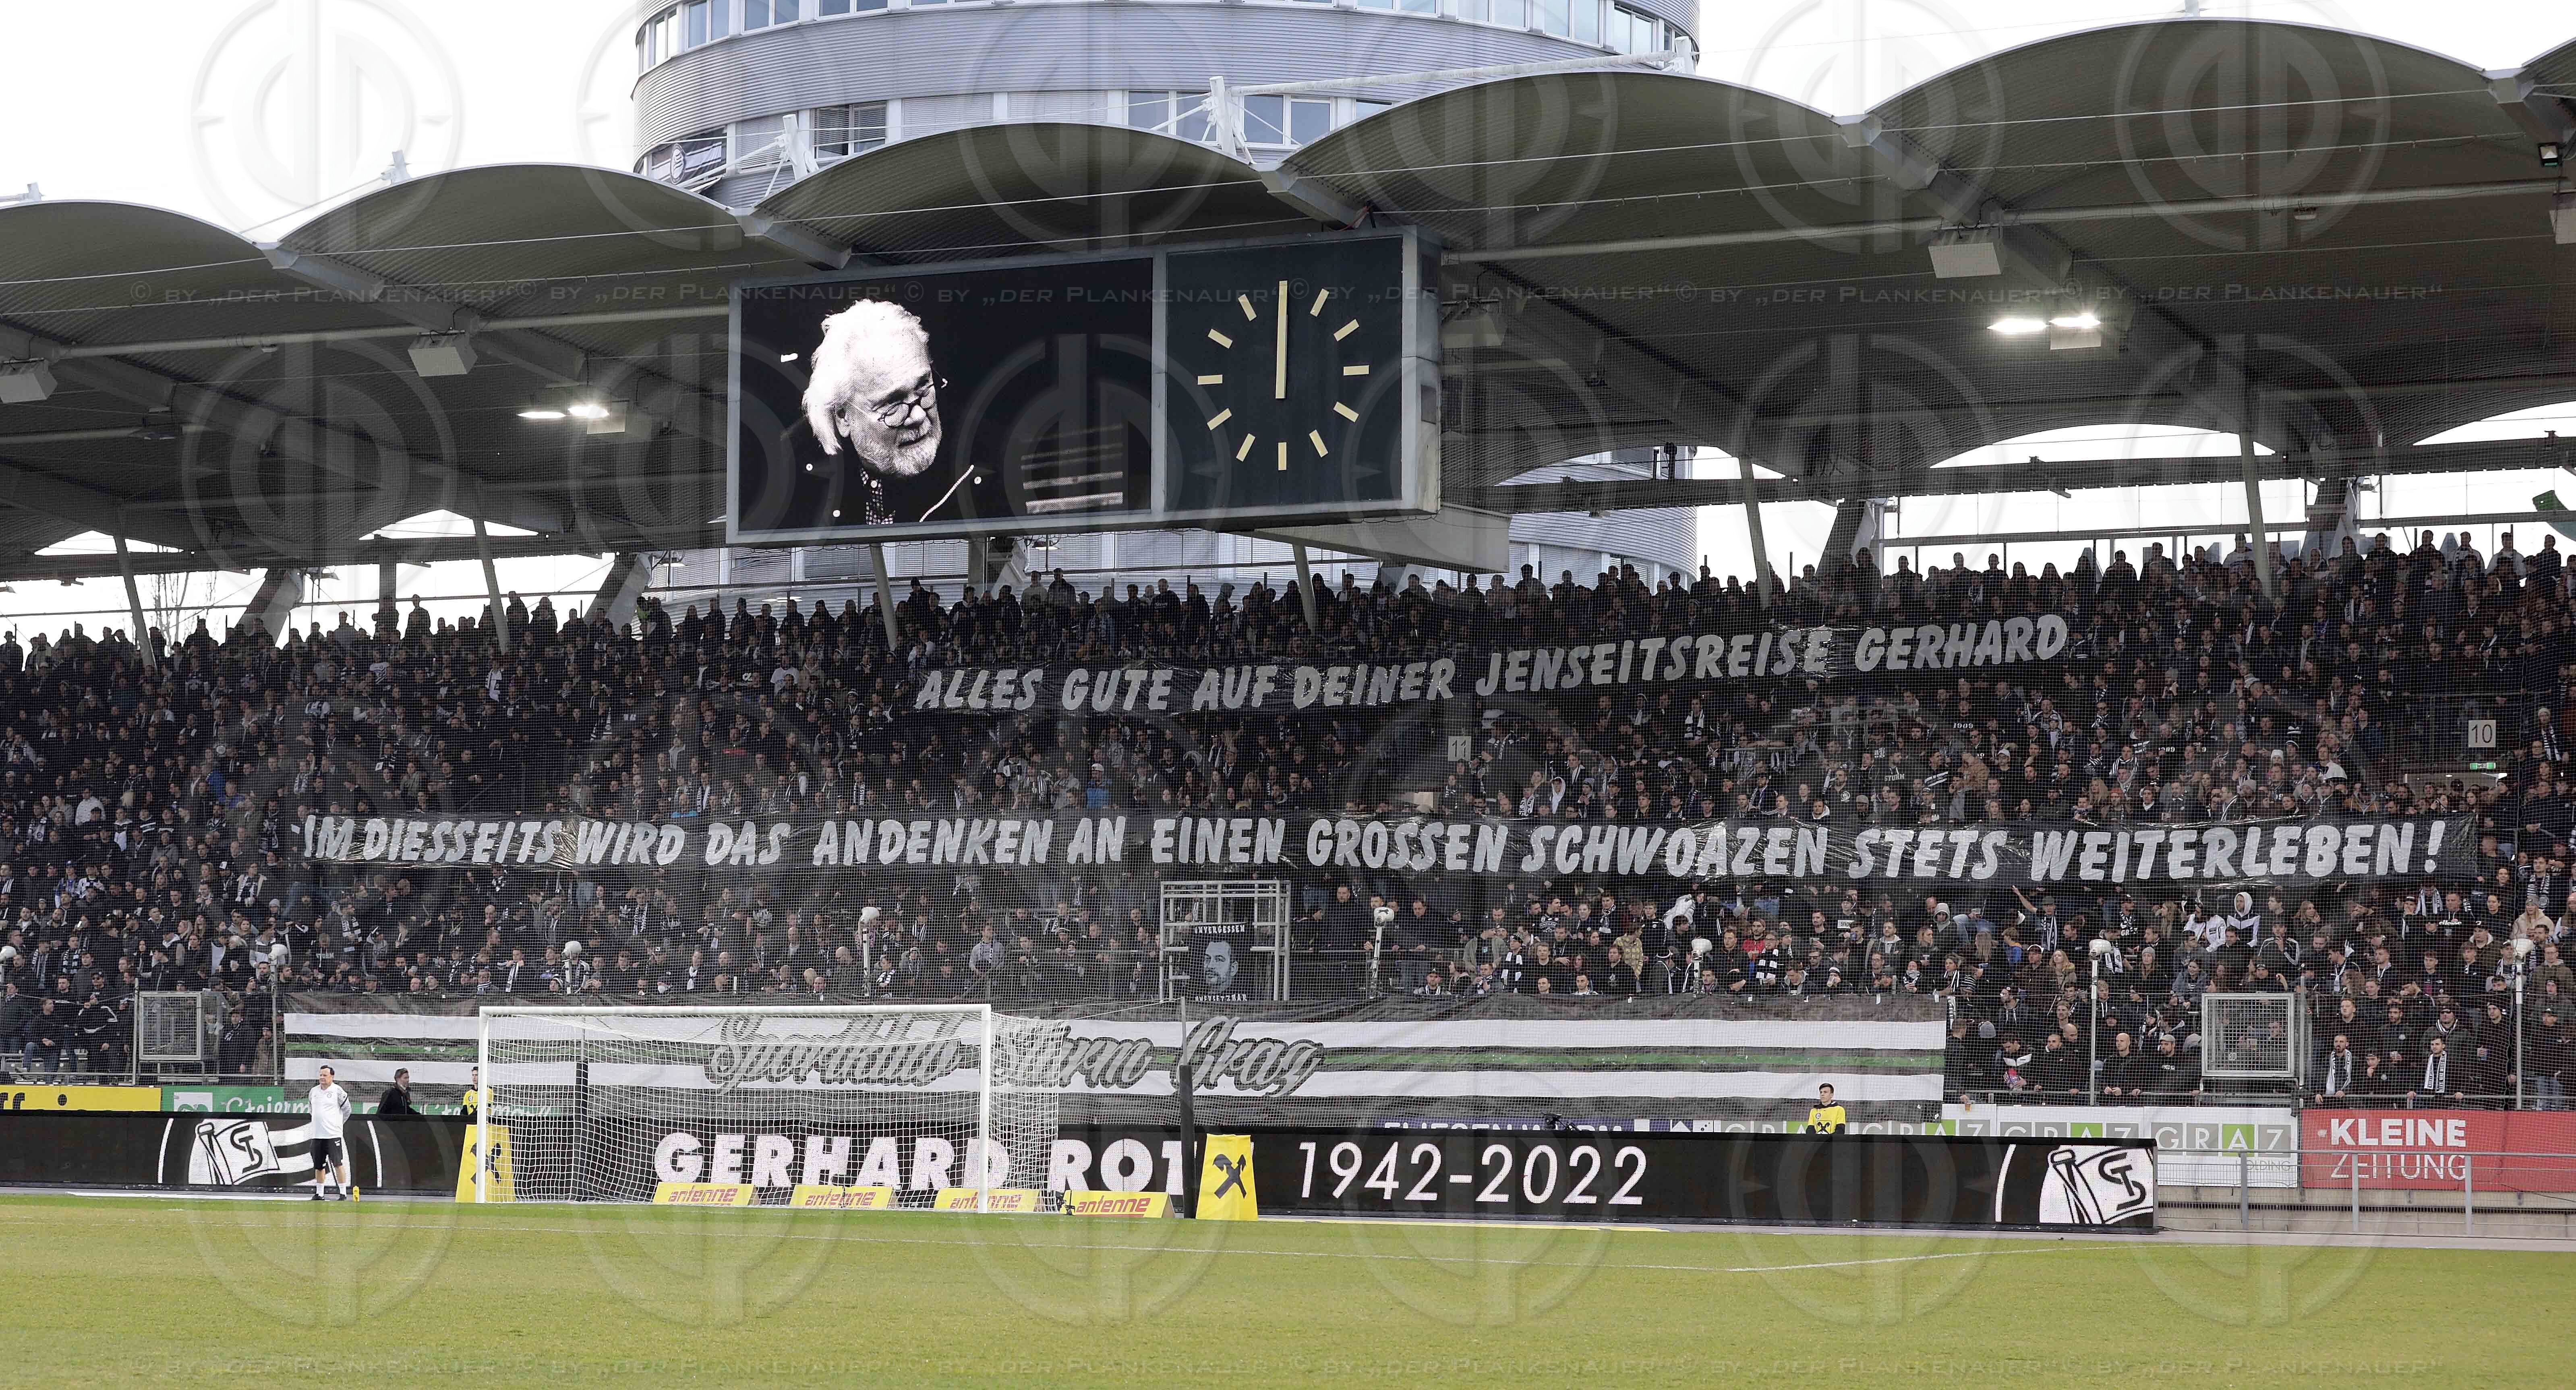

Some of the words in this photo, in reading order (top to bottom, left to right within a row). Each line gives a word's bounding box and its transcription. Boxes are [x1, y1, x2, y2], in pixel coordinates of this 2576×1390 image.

[915, 668, 1043, 711] ALLES
[1062, 669, 1173, 712] GUTE
[1193, 665, 1278, 711] AUF
[1293, 658, 1456, 709] DEINER
[1476, 629, 1834, 696] JENSEITSREISE
[1855, 614, 2068, 672] GERHARD
[2472, 724, 2492, 743] 10
[1452, 739, 1466, 758] 11
[1884, 773, 1905, 781] STURM
[304, 814, 354, 860] IM
[362, 818, 563, 863] DIESSEITS
[575, 821, 685, 866] WIRD
[705, 821, 791, 865] DAS
[813, 818, 1053, 866] ANDENKEN
[1067, 816, 1126, 864] AN
[1151, 817, 1286, 864] EINEN
[1307, 819, 1508, 872] GROSSEN
[1521, 820, 1828, 877] SCHWOAZEN
[1848, 829, 2008, 879] STETS
[1194, 925, 1245, 934] UNVERGESSEN
[2155, 1127, 2284, 1150] GRAZ
[2331, 1118, 2466, 1147] KLEINE
[654, 1132, 1009, 1190] GERHARD
[1050, 1138, 1198, 1196] ROT
[1298, 1141, 1647, 1205] 1942-2022
[2331, 1152, 2466, 1180] ZEITUNG
[668, 1185, 738, 1202] antenne
[805, 1189, 875, 1206] antenne
[950, 1191, 1022, 1209] antnne
[1076, 1195, 1151, 1213] antenne
